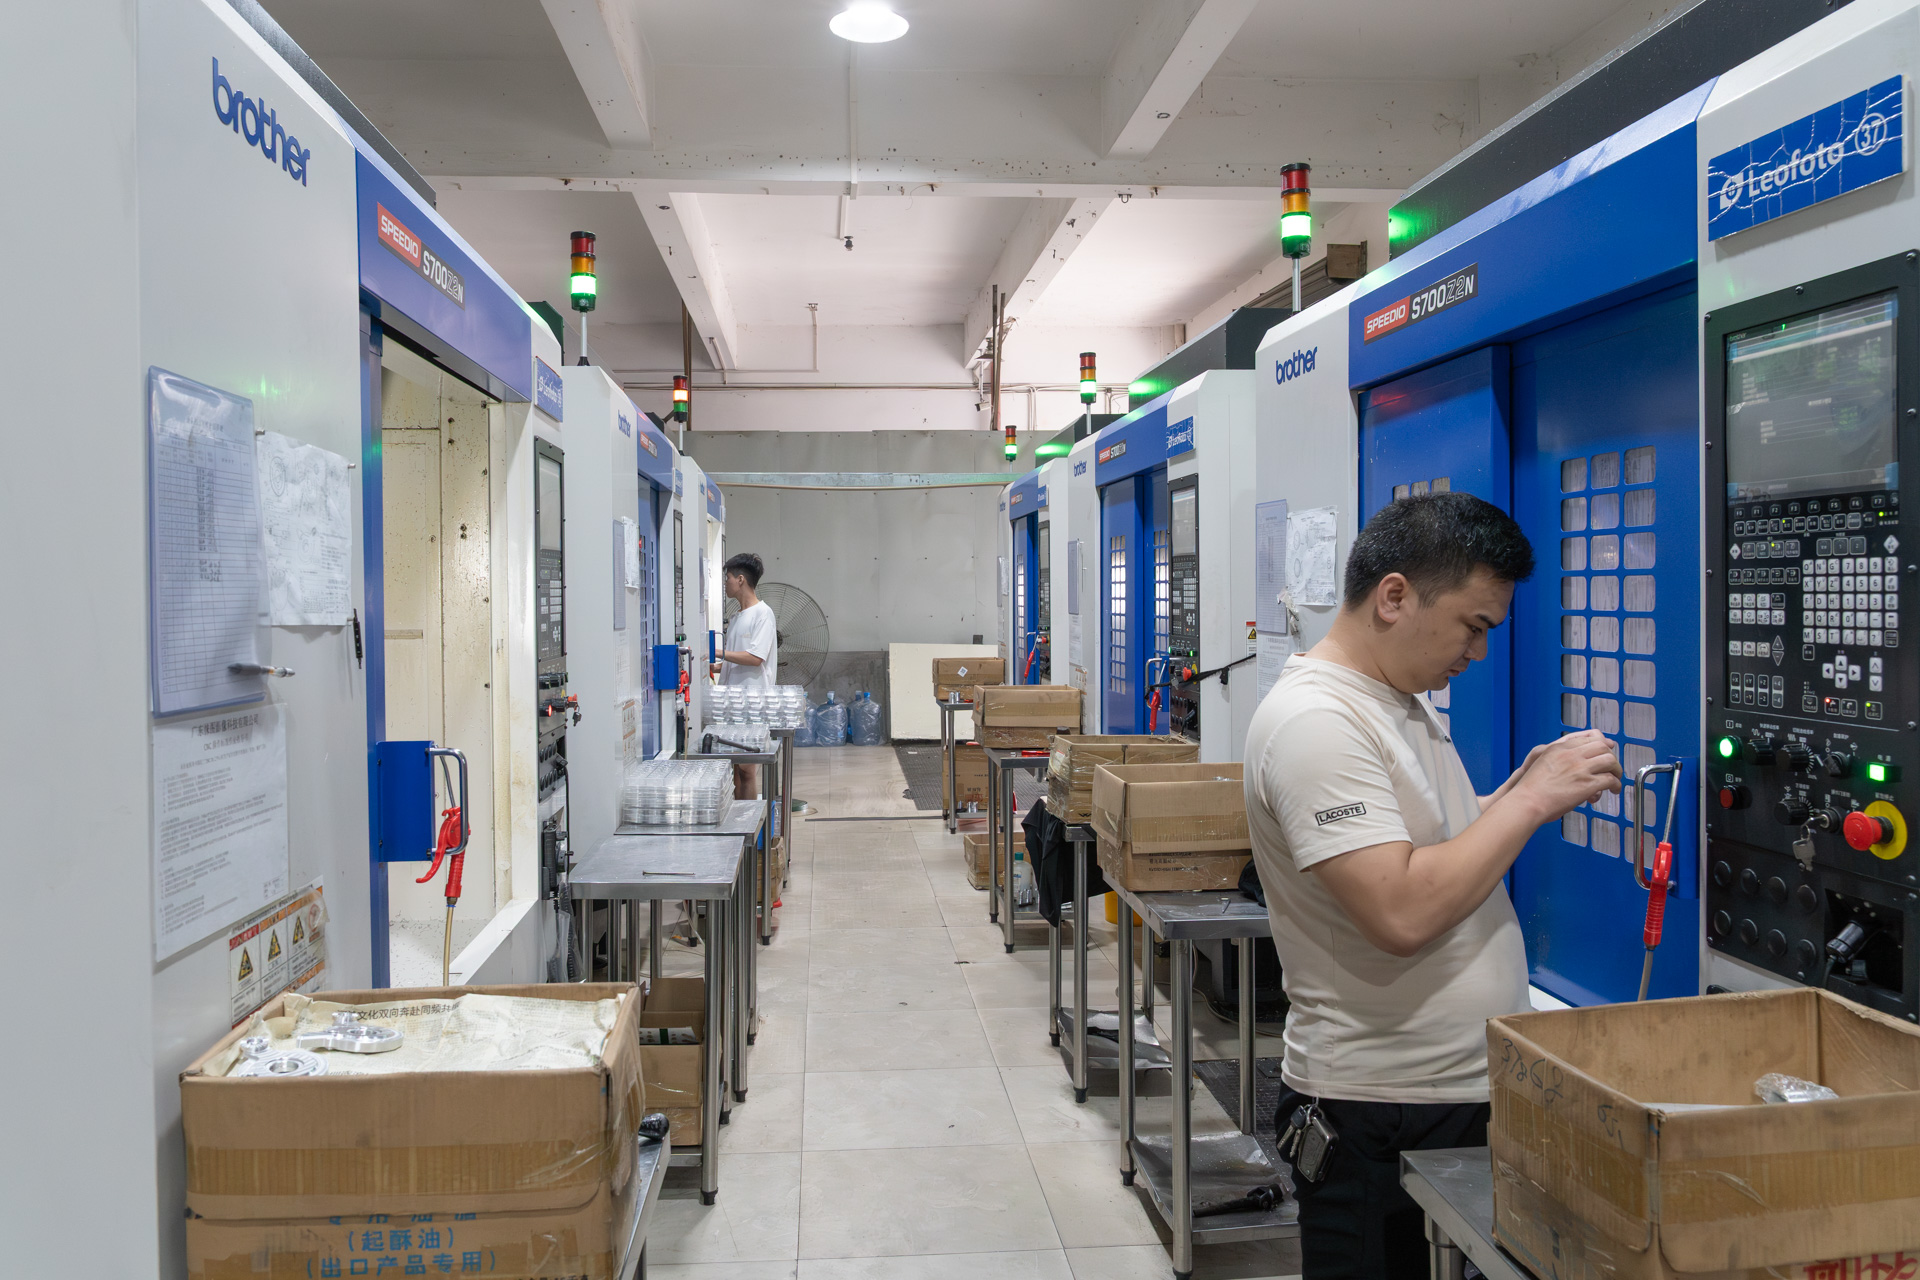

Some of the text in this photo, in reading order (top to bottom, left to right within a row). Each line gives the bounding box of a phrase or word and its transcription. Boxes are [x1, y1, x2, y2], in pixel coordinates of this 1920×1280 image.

[212, 56, 311, 187] brother
[1748, 120, 1881, 198] Leofoto 37
[381, 214, 464, 304] SPEEDIO S700Z2N
[1366, 273, 1475, 335] SPEEDIO S700Z2N
[1275, 346, 1318, 385] brother
[1318, 805, 1362, 822] LACOSTE
